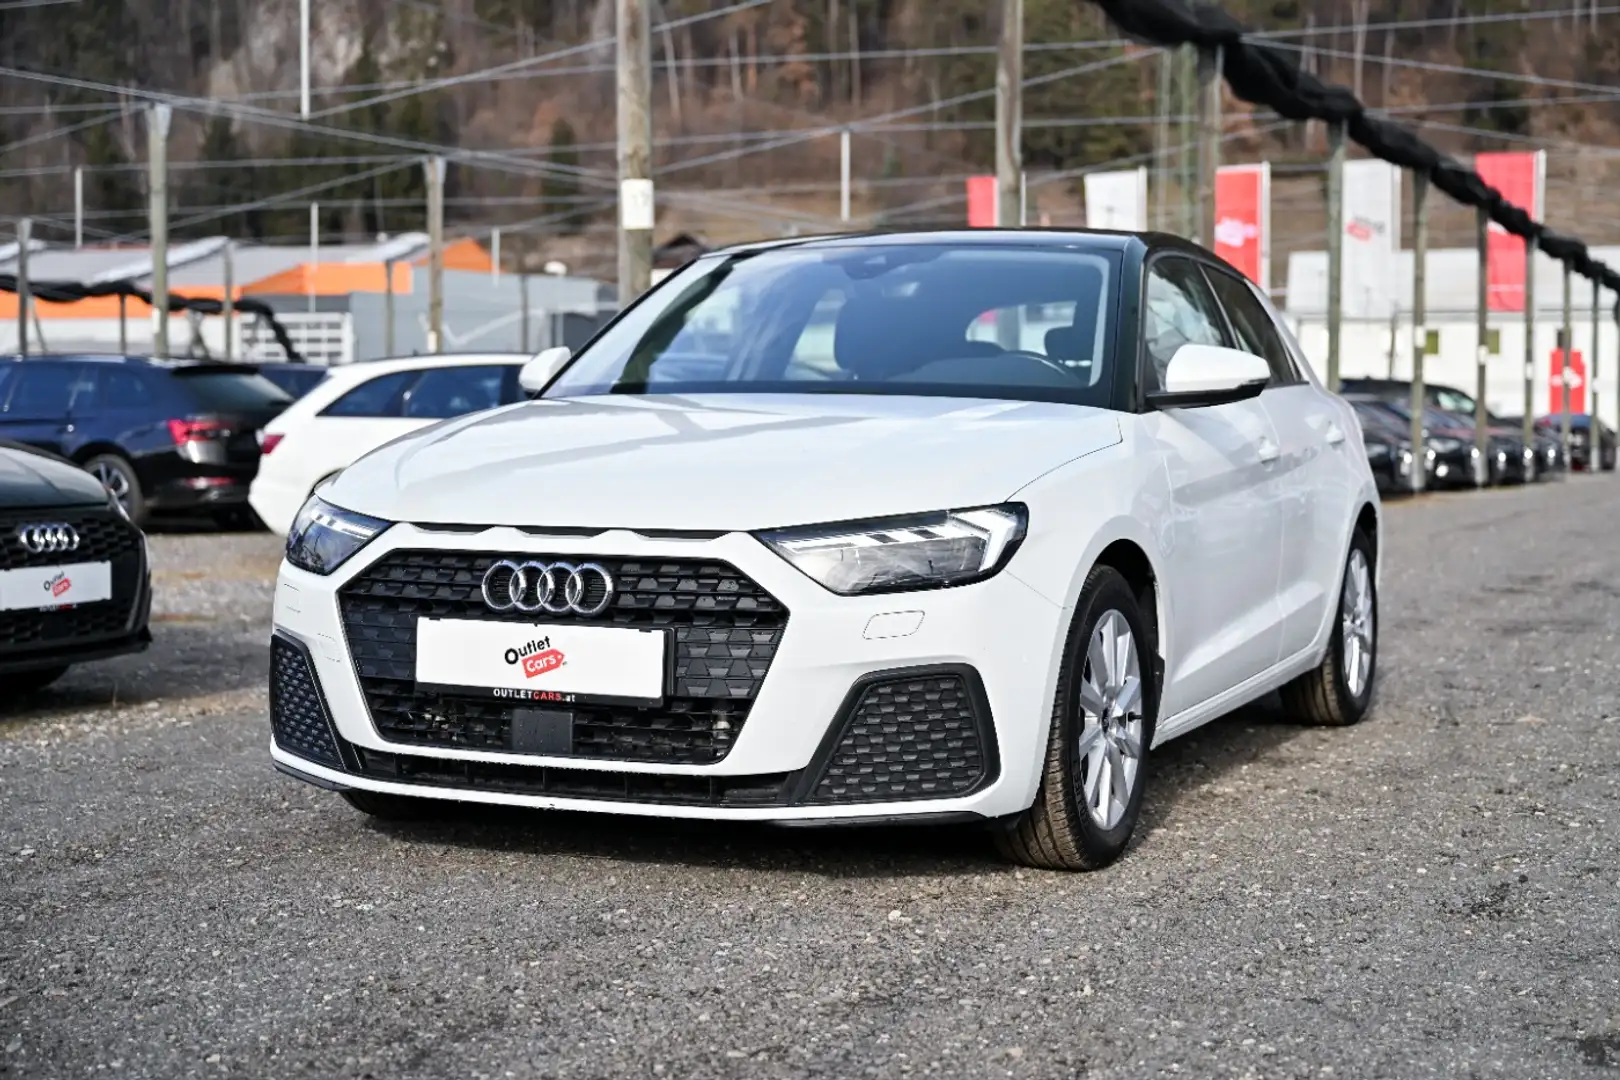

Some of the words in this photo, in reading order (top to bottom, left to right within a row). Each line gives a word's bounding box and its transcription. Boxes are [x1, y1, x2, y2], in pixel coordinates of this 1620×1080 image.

[504, 635, 551, 665] Outlet
[526, 655, 557, 672] Cars
[493, 688, 576, 702] OUTLETCARS.at
